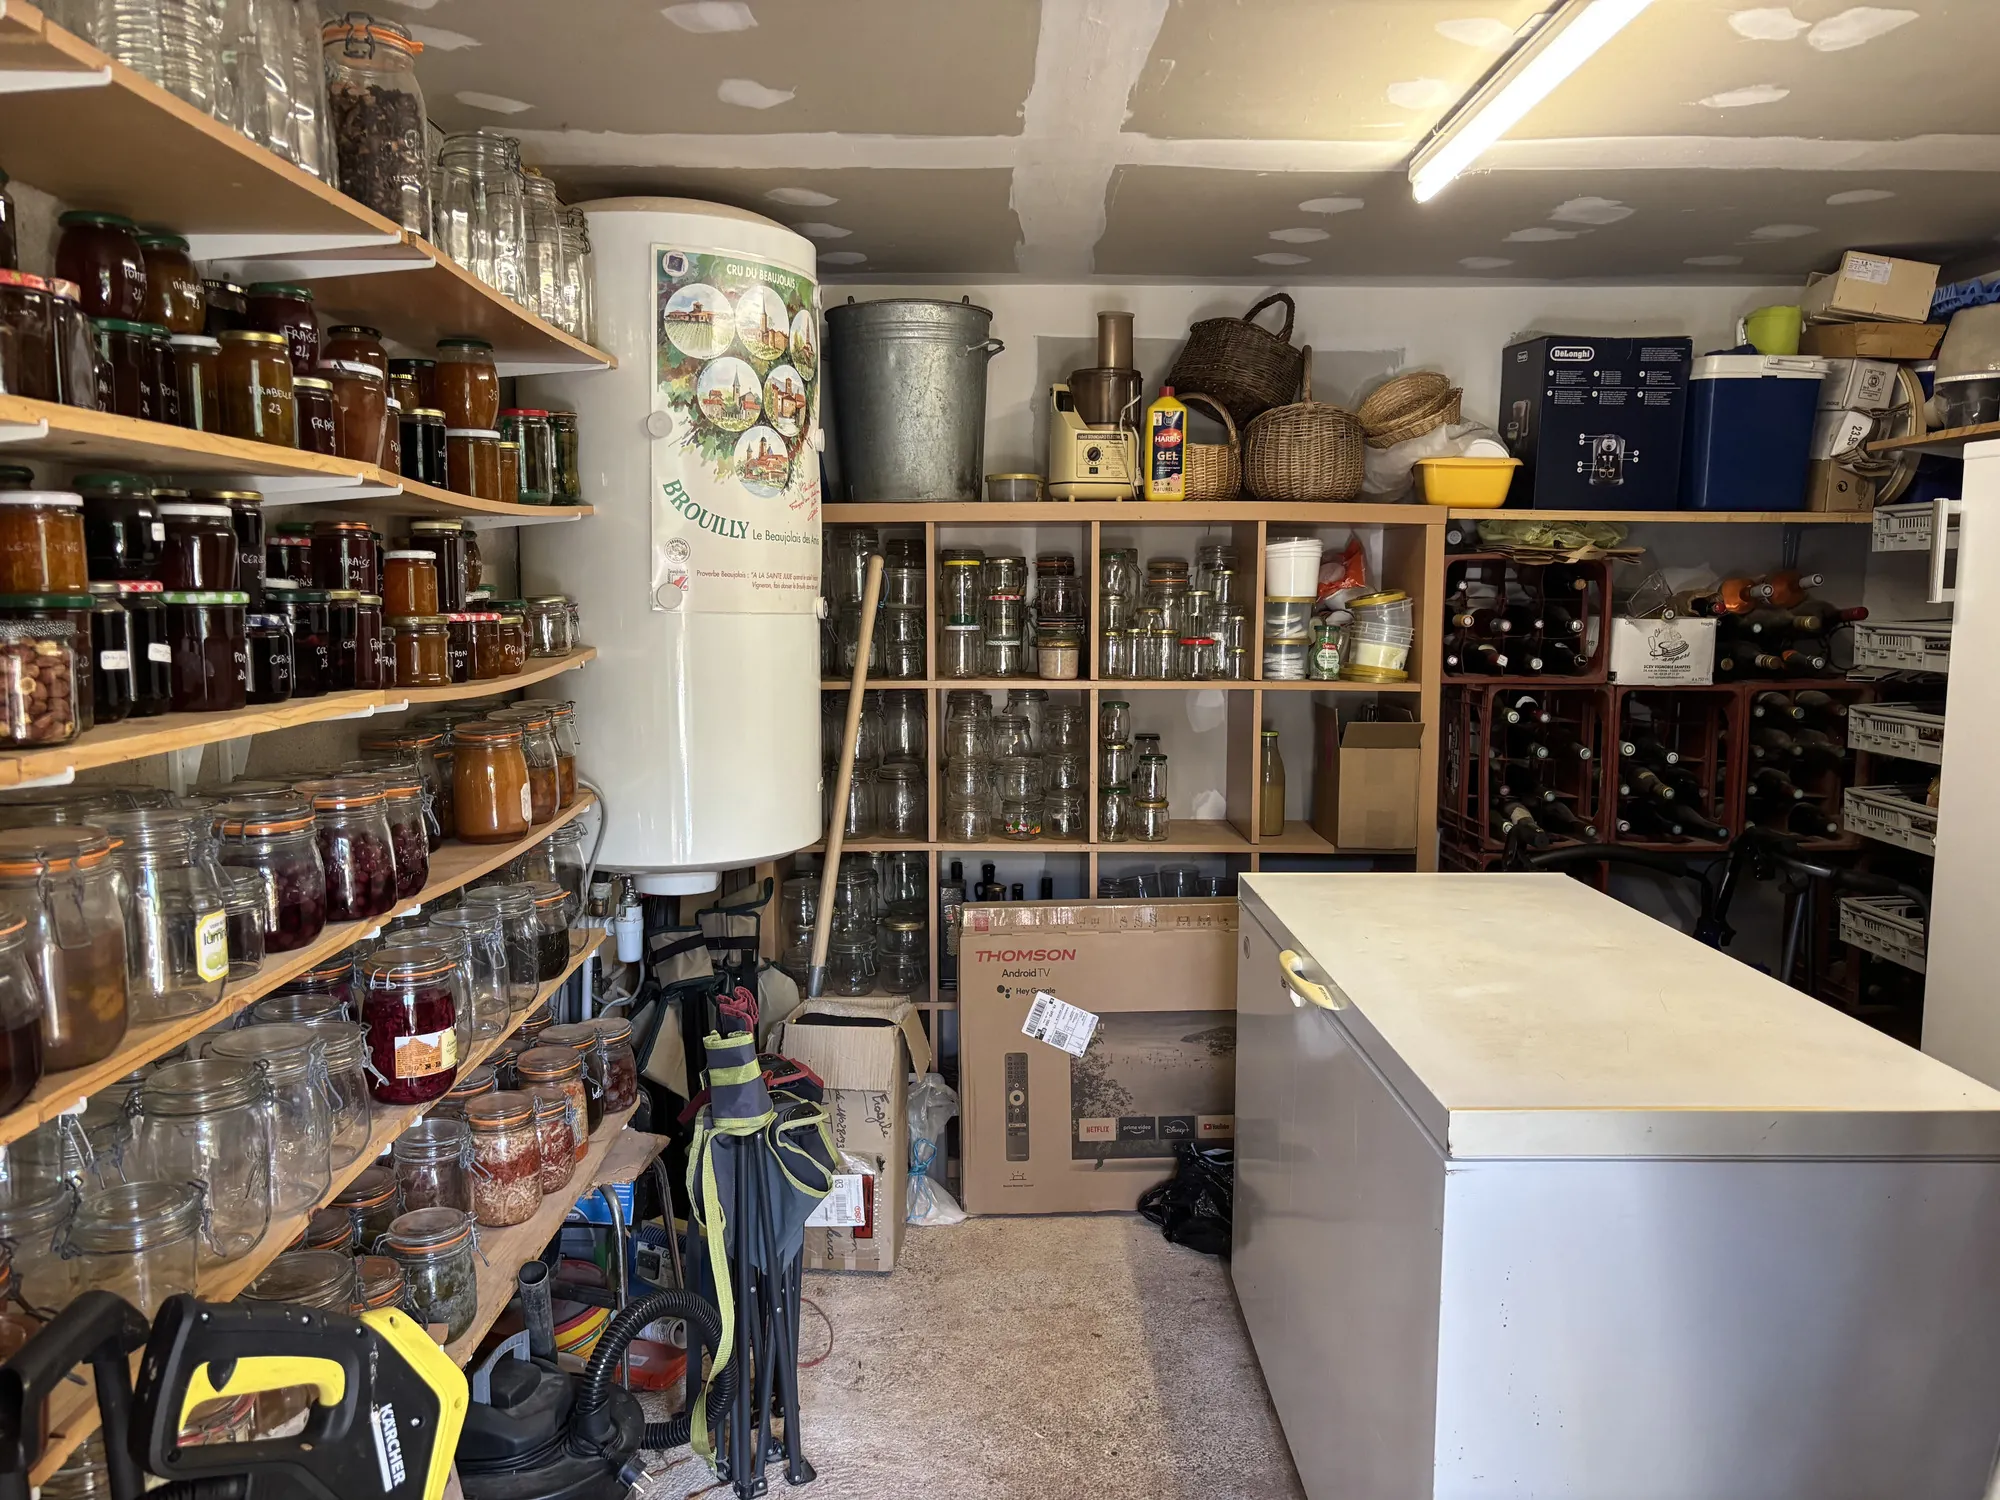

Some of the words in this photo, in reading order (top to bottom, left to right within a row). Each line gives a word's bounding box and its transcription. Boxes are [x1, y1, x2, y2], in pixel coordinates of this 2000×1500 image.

[727, 264, 743, 276] CRU
[746, 268, 757, 279] DU
[760, 269, 796, 288] BEAUJOLAIS
[295, 345, 310, 360] 24
[268, 402, 282, 415] 23
[1155, 434, 1181, 443] HARRIS
[1157, 451, 1179, 461] GEL
[663, 479, 750, 539] BROUILLY
[753, 530, 762, 540] Le
[766, 530, 801, 545] Beaujolais
[803, 535, 811, 544] des
[697, 570, 720, 578] Proverbe
[721, 571, 746, 581] Beaujolais
[766, 572, 782, 580] SAINTE
[752, 582, 772, 590] Vigneron,
[976, 949, 1076, 963] THOMSON
[1002, 968, 1037, 978] Android
[1038, 968, 1051, 978] TV
[1016, 988, 1031, 996] Hey
[380, 1402, 407, 1486] KÄRCHER
